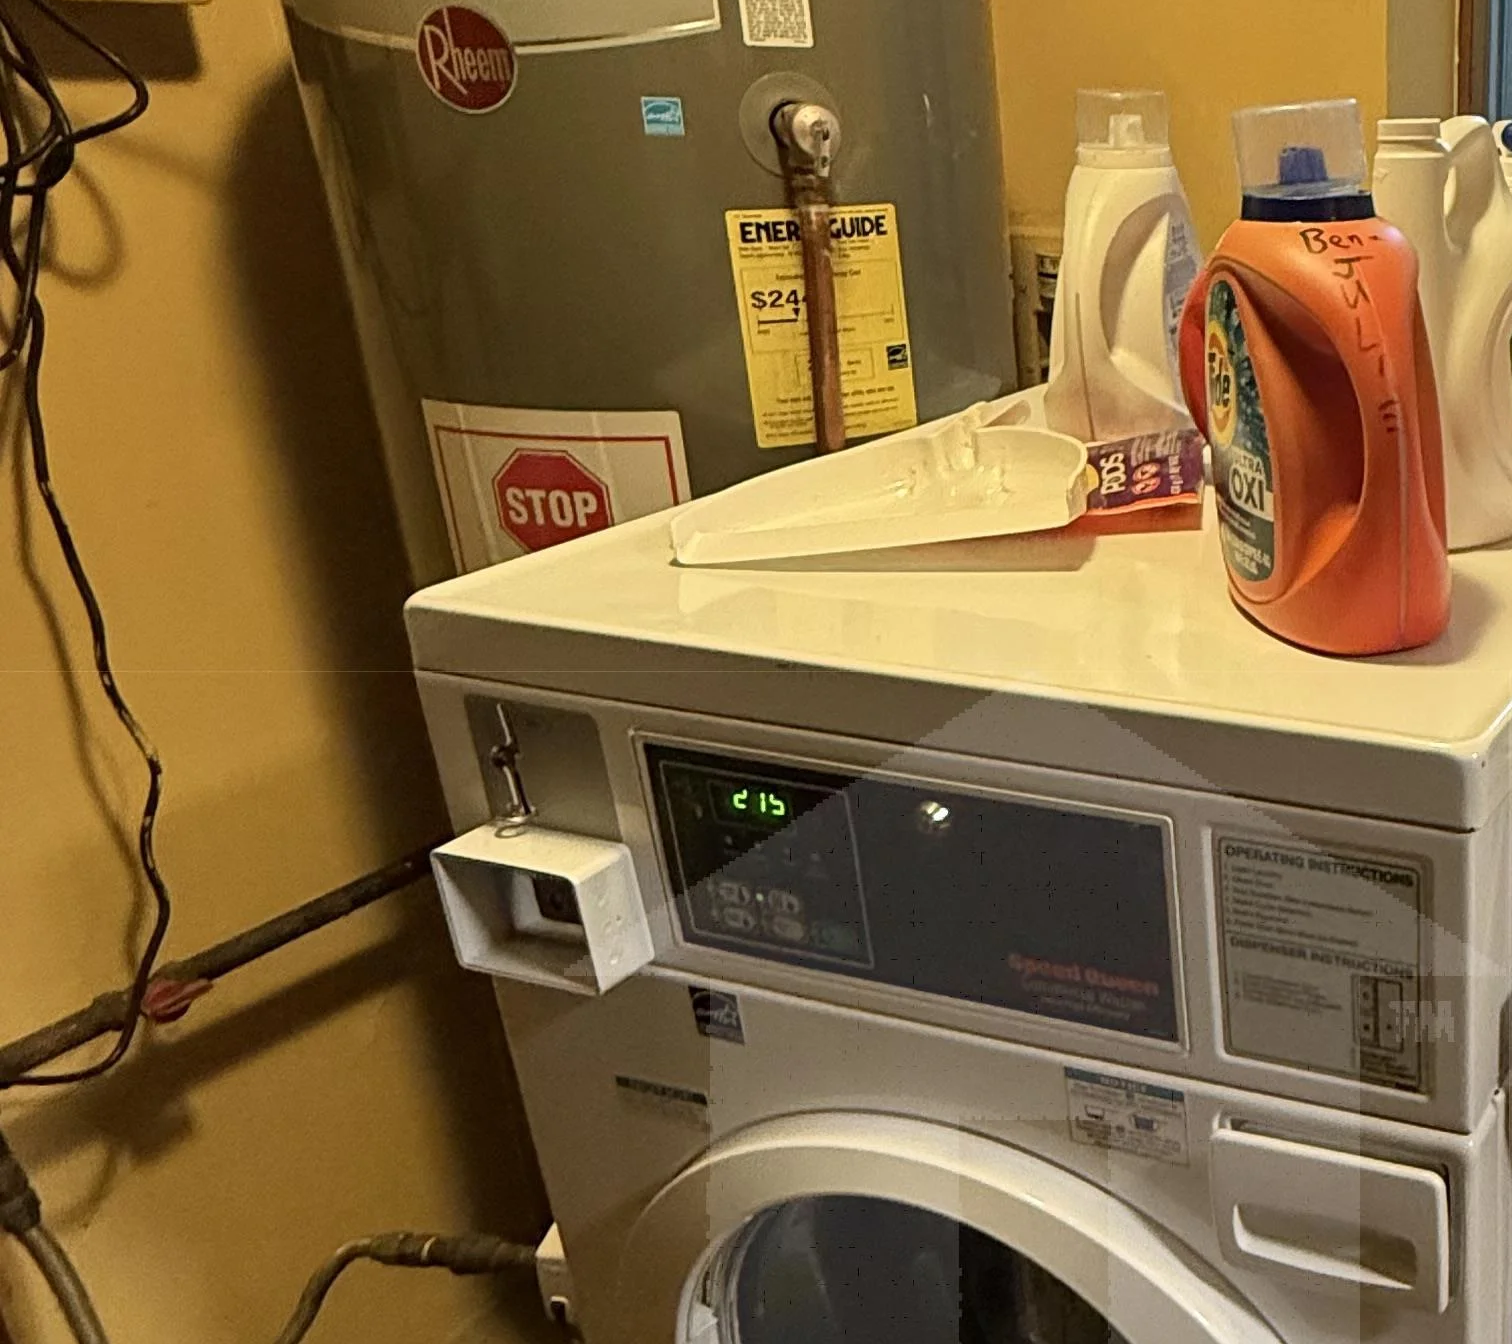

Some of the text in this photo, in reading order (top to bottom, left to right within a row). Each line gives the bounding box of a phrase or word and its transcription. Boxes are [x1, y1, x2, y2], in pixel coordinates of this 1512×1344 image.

[423, 7, 513, 95] Rheem
[739, 215, 888, 244] ENERGUIDE
[750, 289, 808, 310] $24
[1100, 453, 1127, 496] PODS
[1231, 466, 1265, 512] OXI
[505, 487, 598, 529] STOP
[1225, 845, 1414, 888] OPERATING INSTRUCTIONS
[1311, 952, 1414, 981] INSTRUCTIONS
